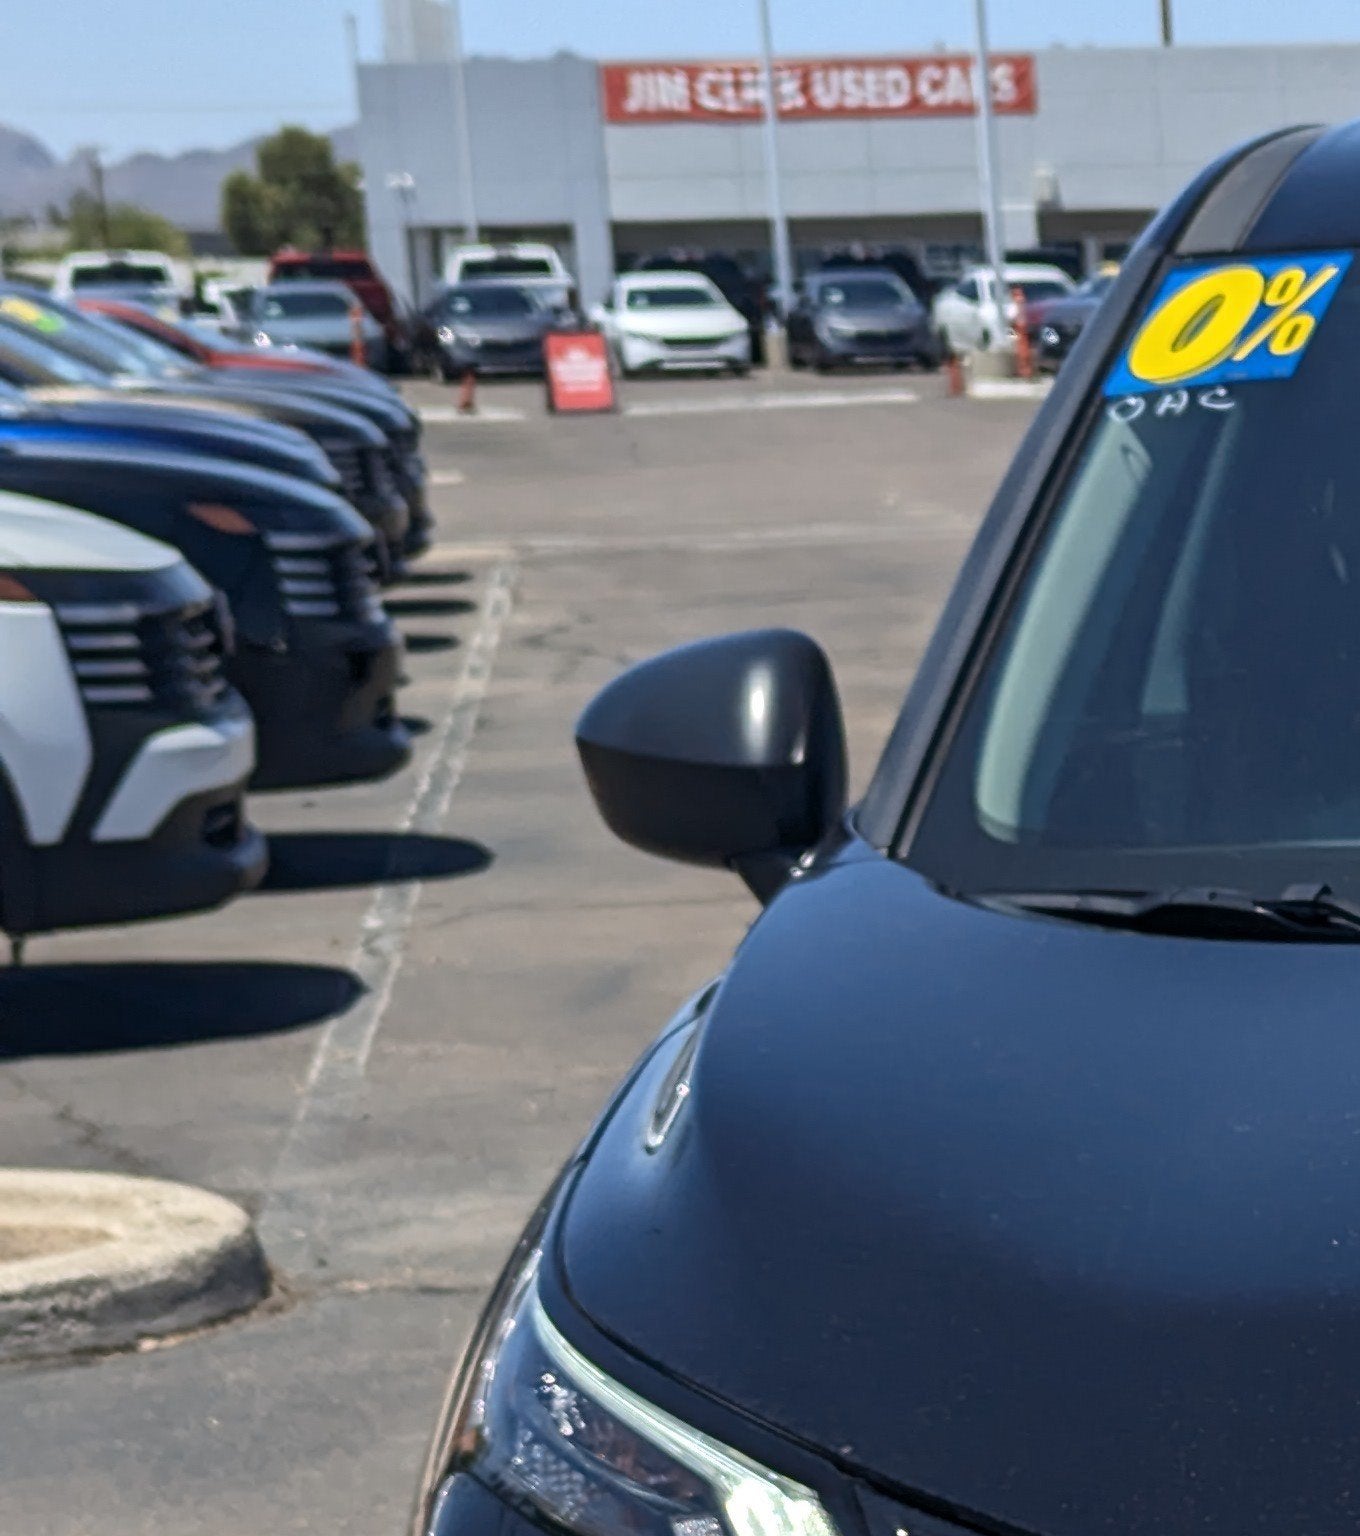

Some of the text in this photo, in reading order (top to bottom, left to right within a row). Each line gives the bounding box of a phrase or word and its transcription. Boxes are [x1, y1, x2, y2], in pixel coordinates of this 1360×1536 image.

[624, 68, 691, 113] JIM
[810, 65, 910, 110] USED
[916, 62, 1018, 107] CAS
[1128, 264, 1339, 384] 0%
